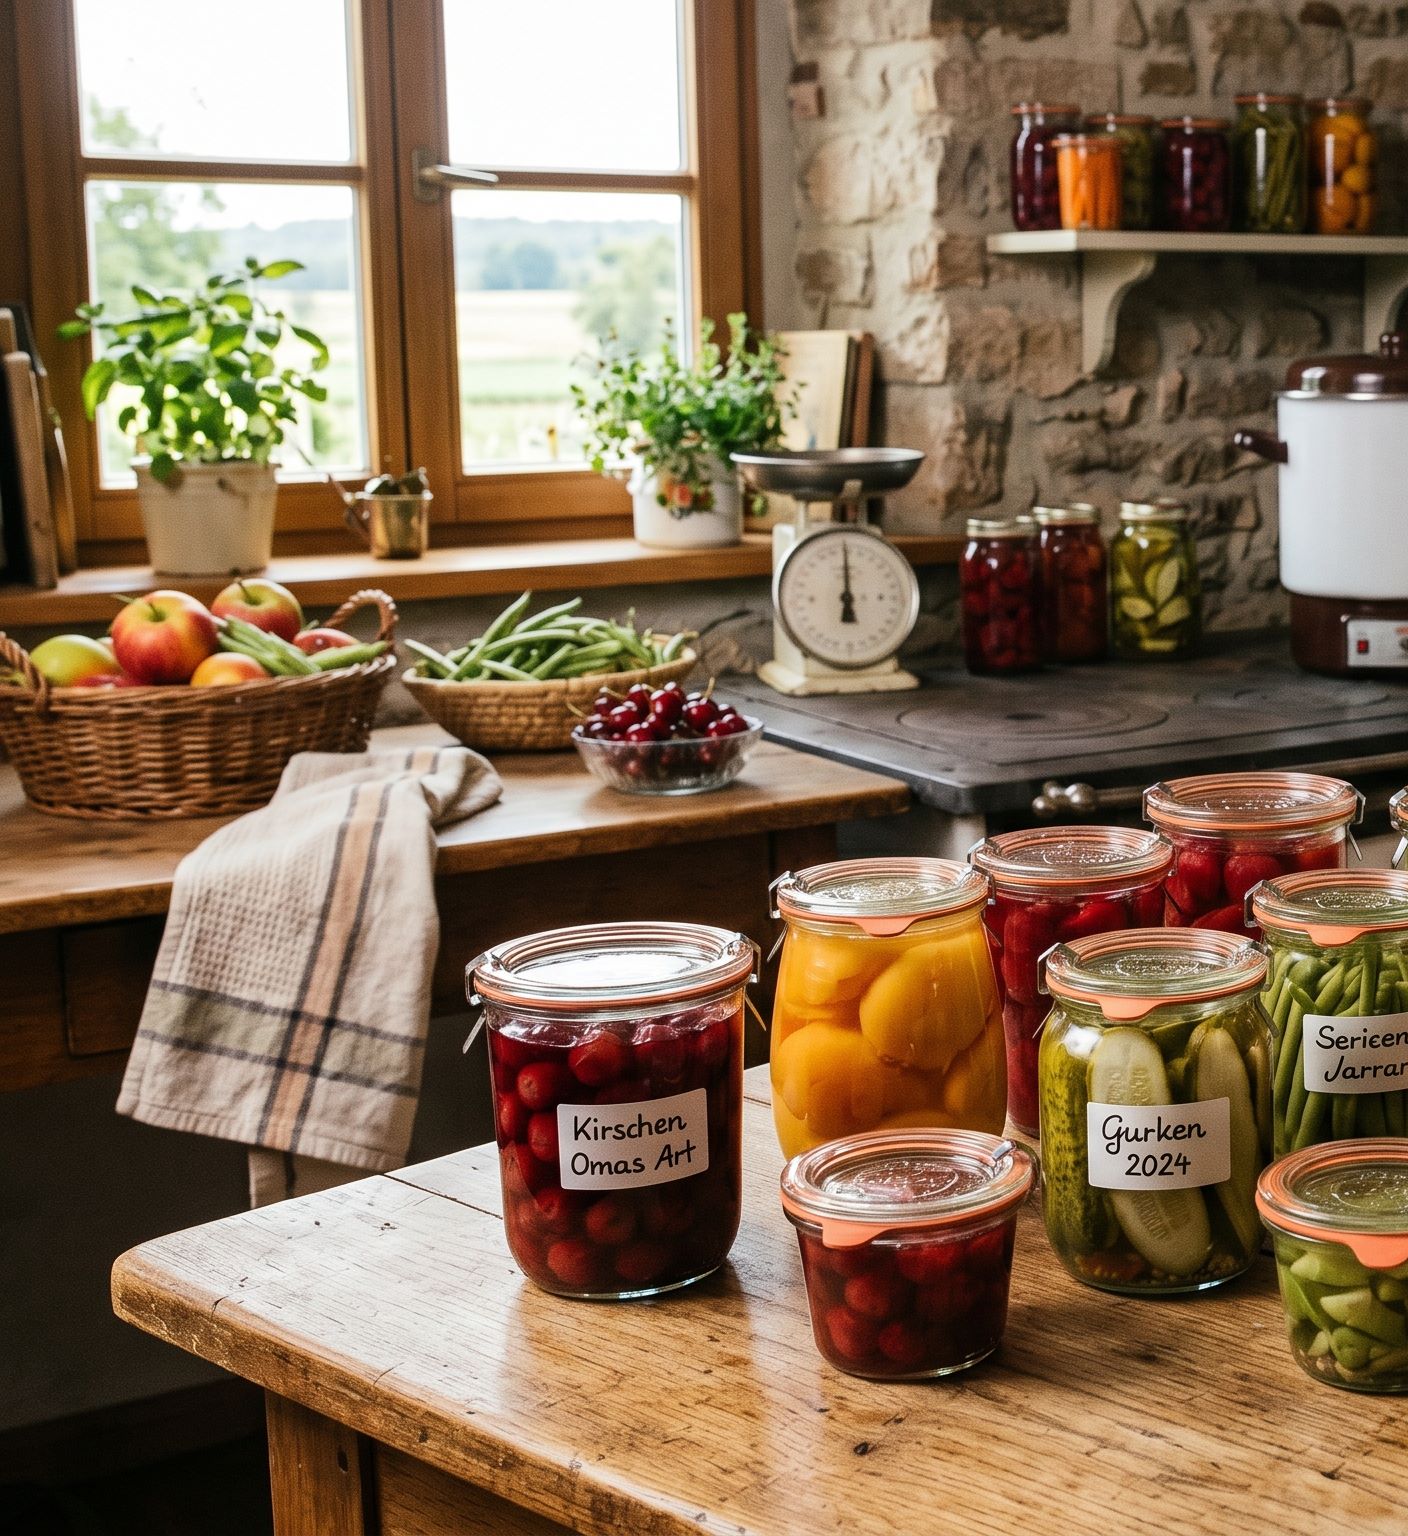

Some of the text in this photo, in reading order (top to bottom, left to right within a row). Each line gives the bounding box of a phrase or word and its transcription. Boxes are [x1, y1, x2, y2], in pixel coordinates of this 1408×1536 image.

[1324, 1055, 1408, 1083] Jarrar
[573, 1113, 687, 1141] Kirschen
[1101, 1114, 1207, 1155] Gurken
[570, 1139, 697, 1176] Omas Art
[1124, 1152, 1191, 1177] 2024
